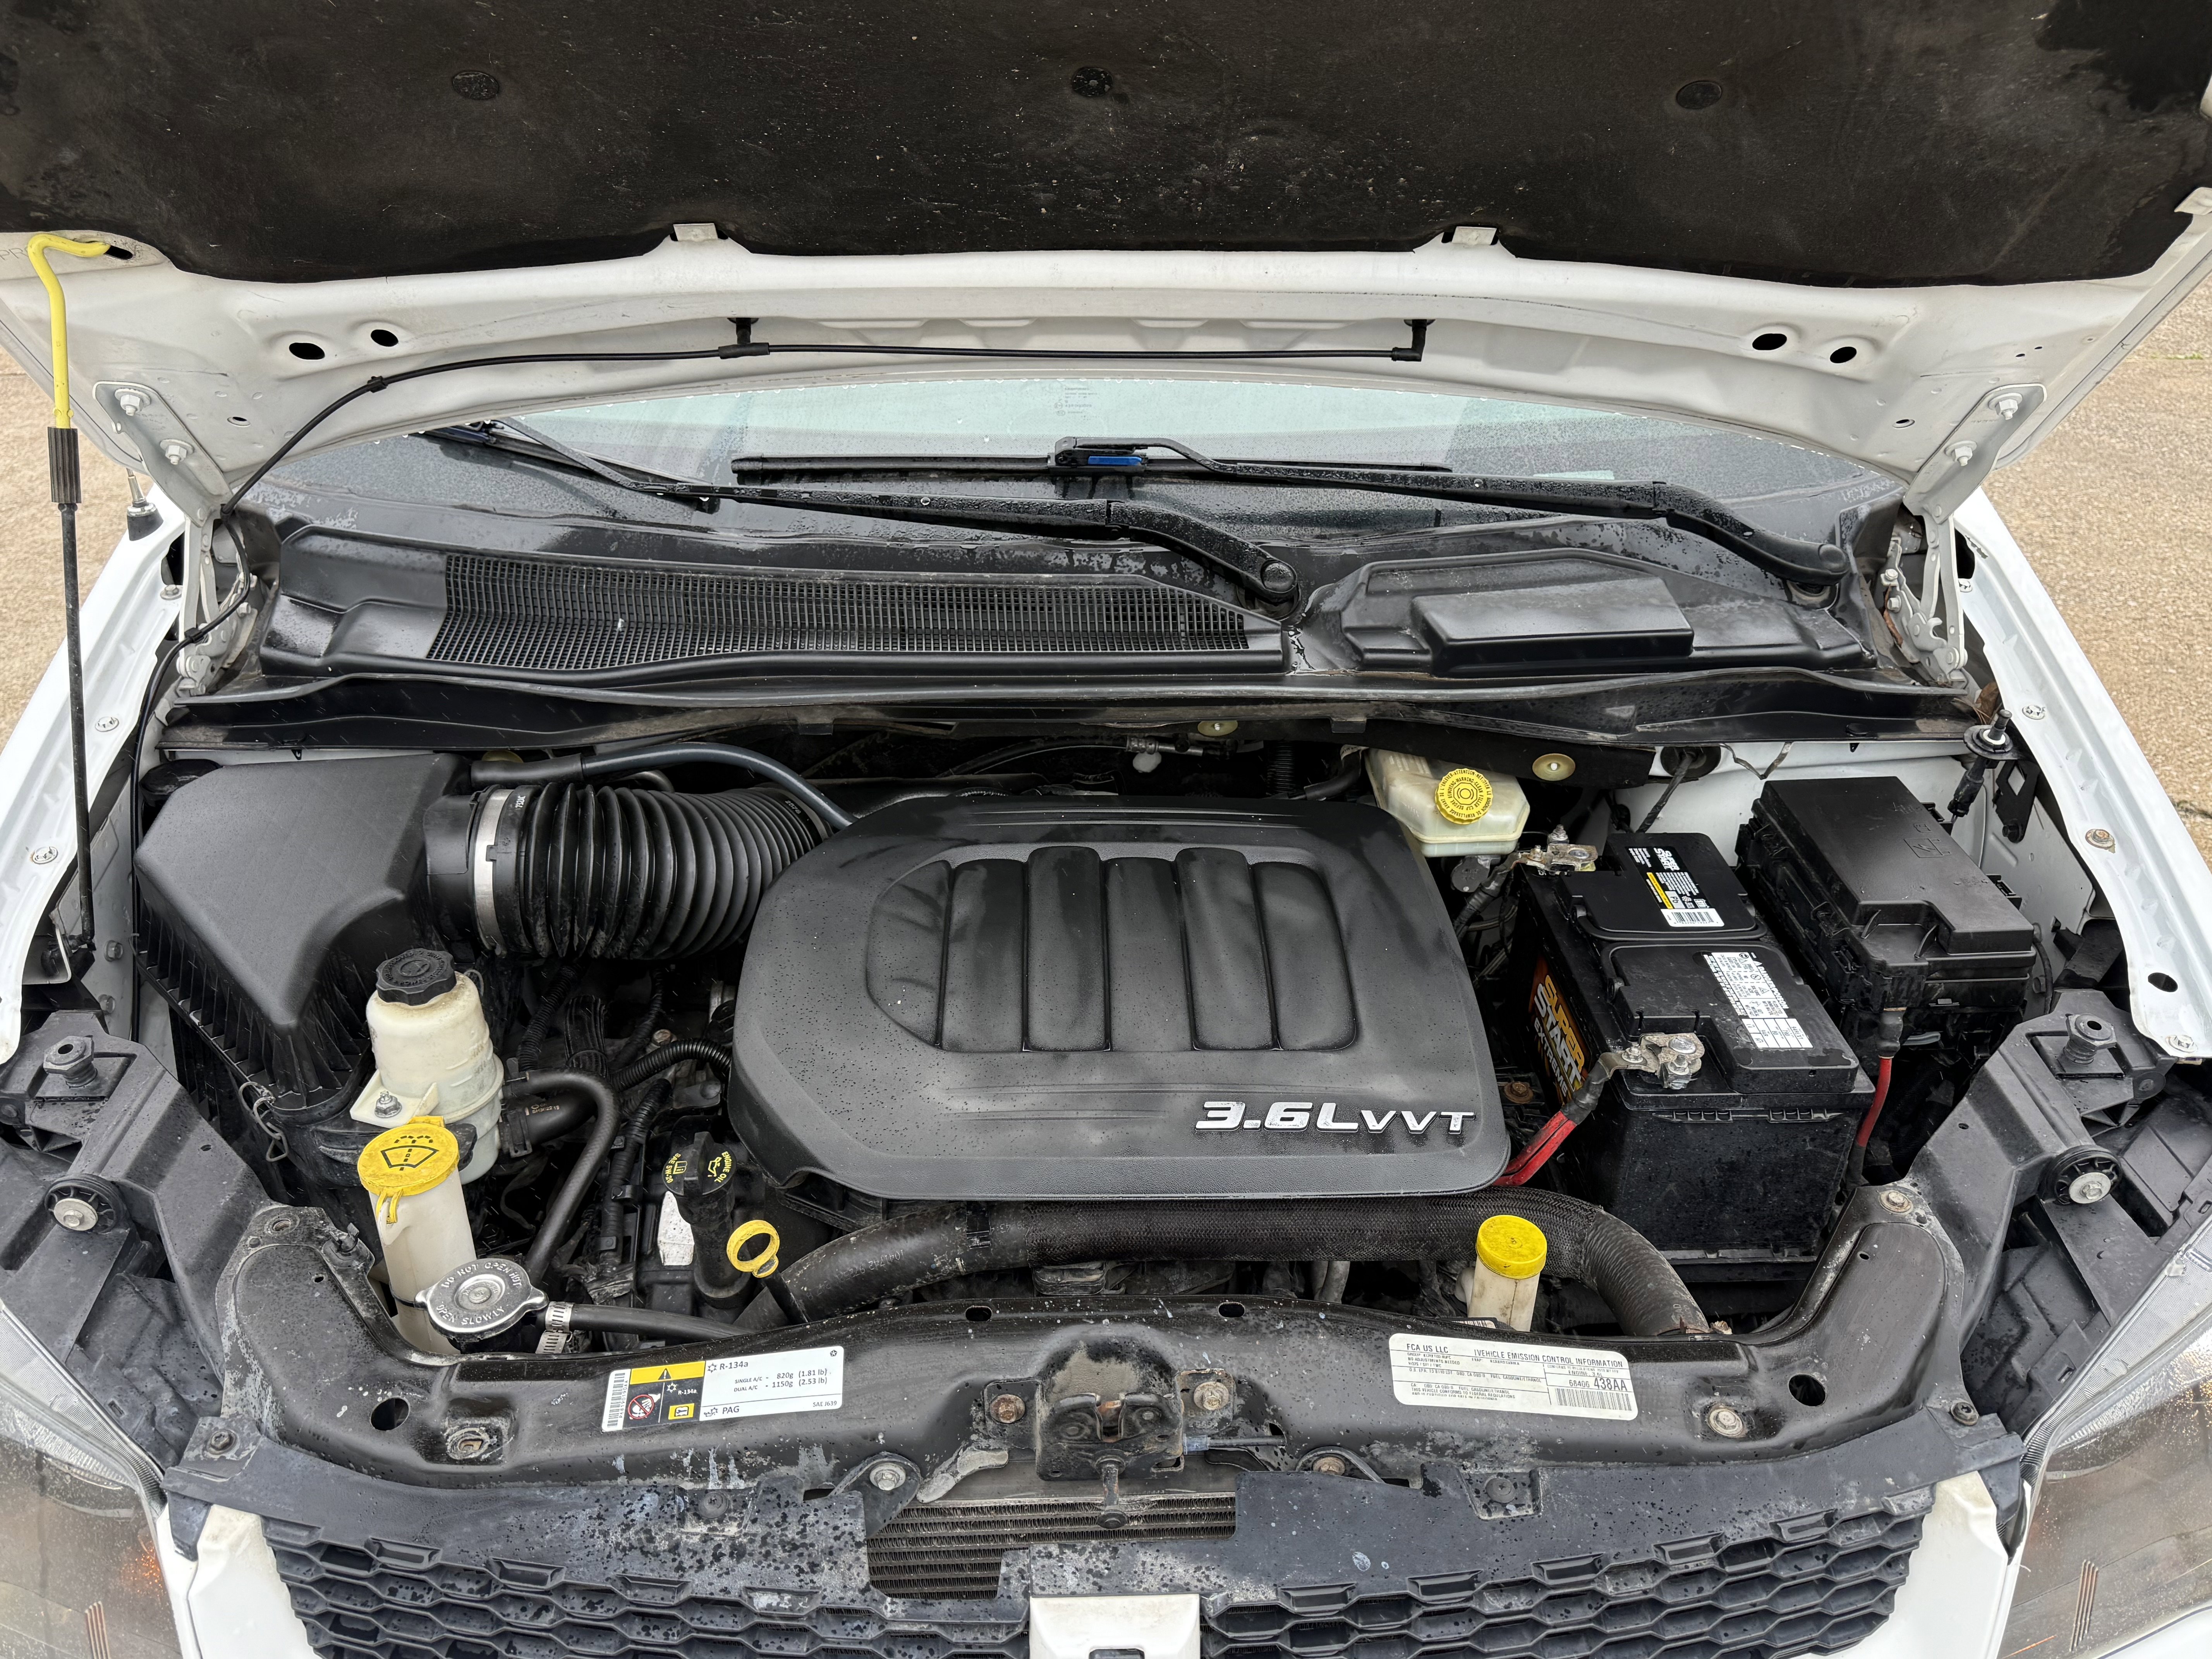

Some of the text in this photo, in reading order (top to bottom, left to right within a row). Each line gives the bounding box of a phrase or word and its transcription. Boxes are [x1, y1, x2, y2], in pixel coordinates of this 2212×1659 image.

[1654, 848, 1672, 871] START
[1664, 850, 1680, 871] SUPER
[1545, 975, 1585, 1072] SUPER
[1534, 983, 1582, 1088] START
[1534, 1018, 1568, 1097] EXTREME
[1360, 1110, 1475, 1134] VVT
[665, 1152, 681, 1184] SAE 5W-20
[714, 1151, 732, 1183] ENGINE OIL
[441, 1262, 522, 1289] DO NOT OPEN HOT
[436, 1304, 506, 1326] OPEN SLOWLY
[720, 1361, 748, 1370] R-134a
[1508, 1352, 1540, 1361] EMISSION
[1542, 1355, 1573, 1364] CONTROL
[1576, 1358, 1623, 1367] INFORMATION
[772, 1380, 793, 1389] 1150g
[798, 1378, 816, 1387] (2.53
[818, 1376, 827, 1385] lb)
[776, 1372, 793, 1381] 820g
[798, 1369, 816, 1378] (1.81
[818, 1368, 827, 1376] lb)
[1569, 1377, 1628, 1391] 68406 438AA
[722, 1405, 740, 1414] PAG
